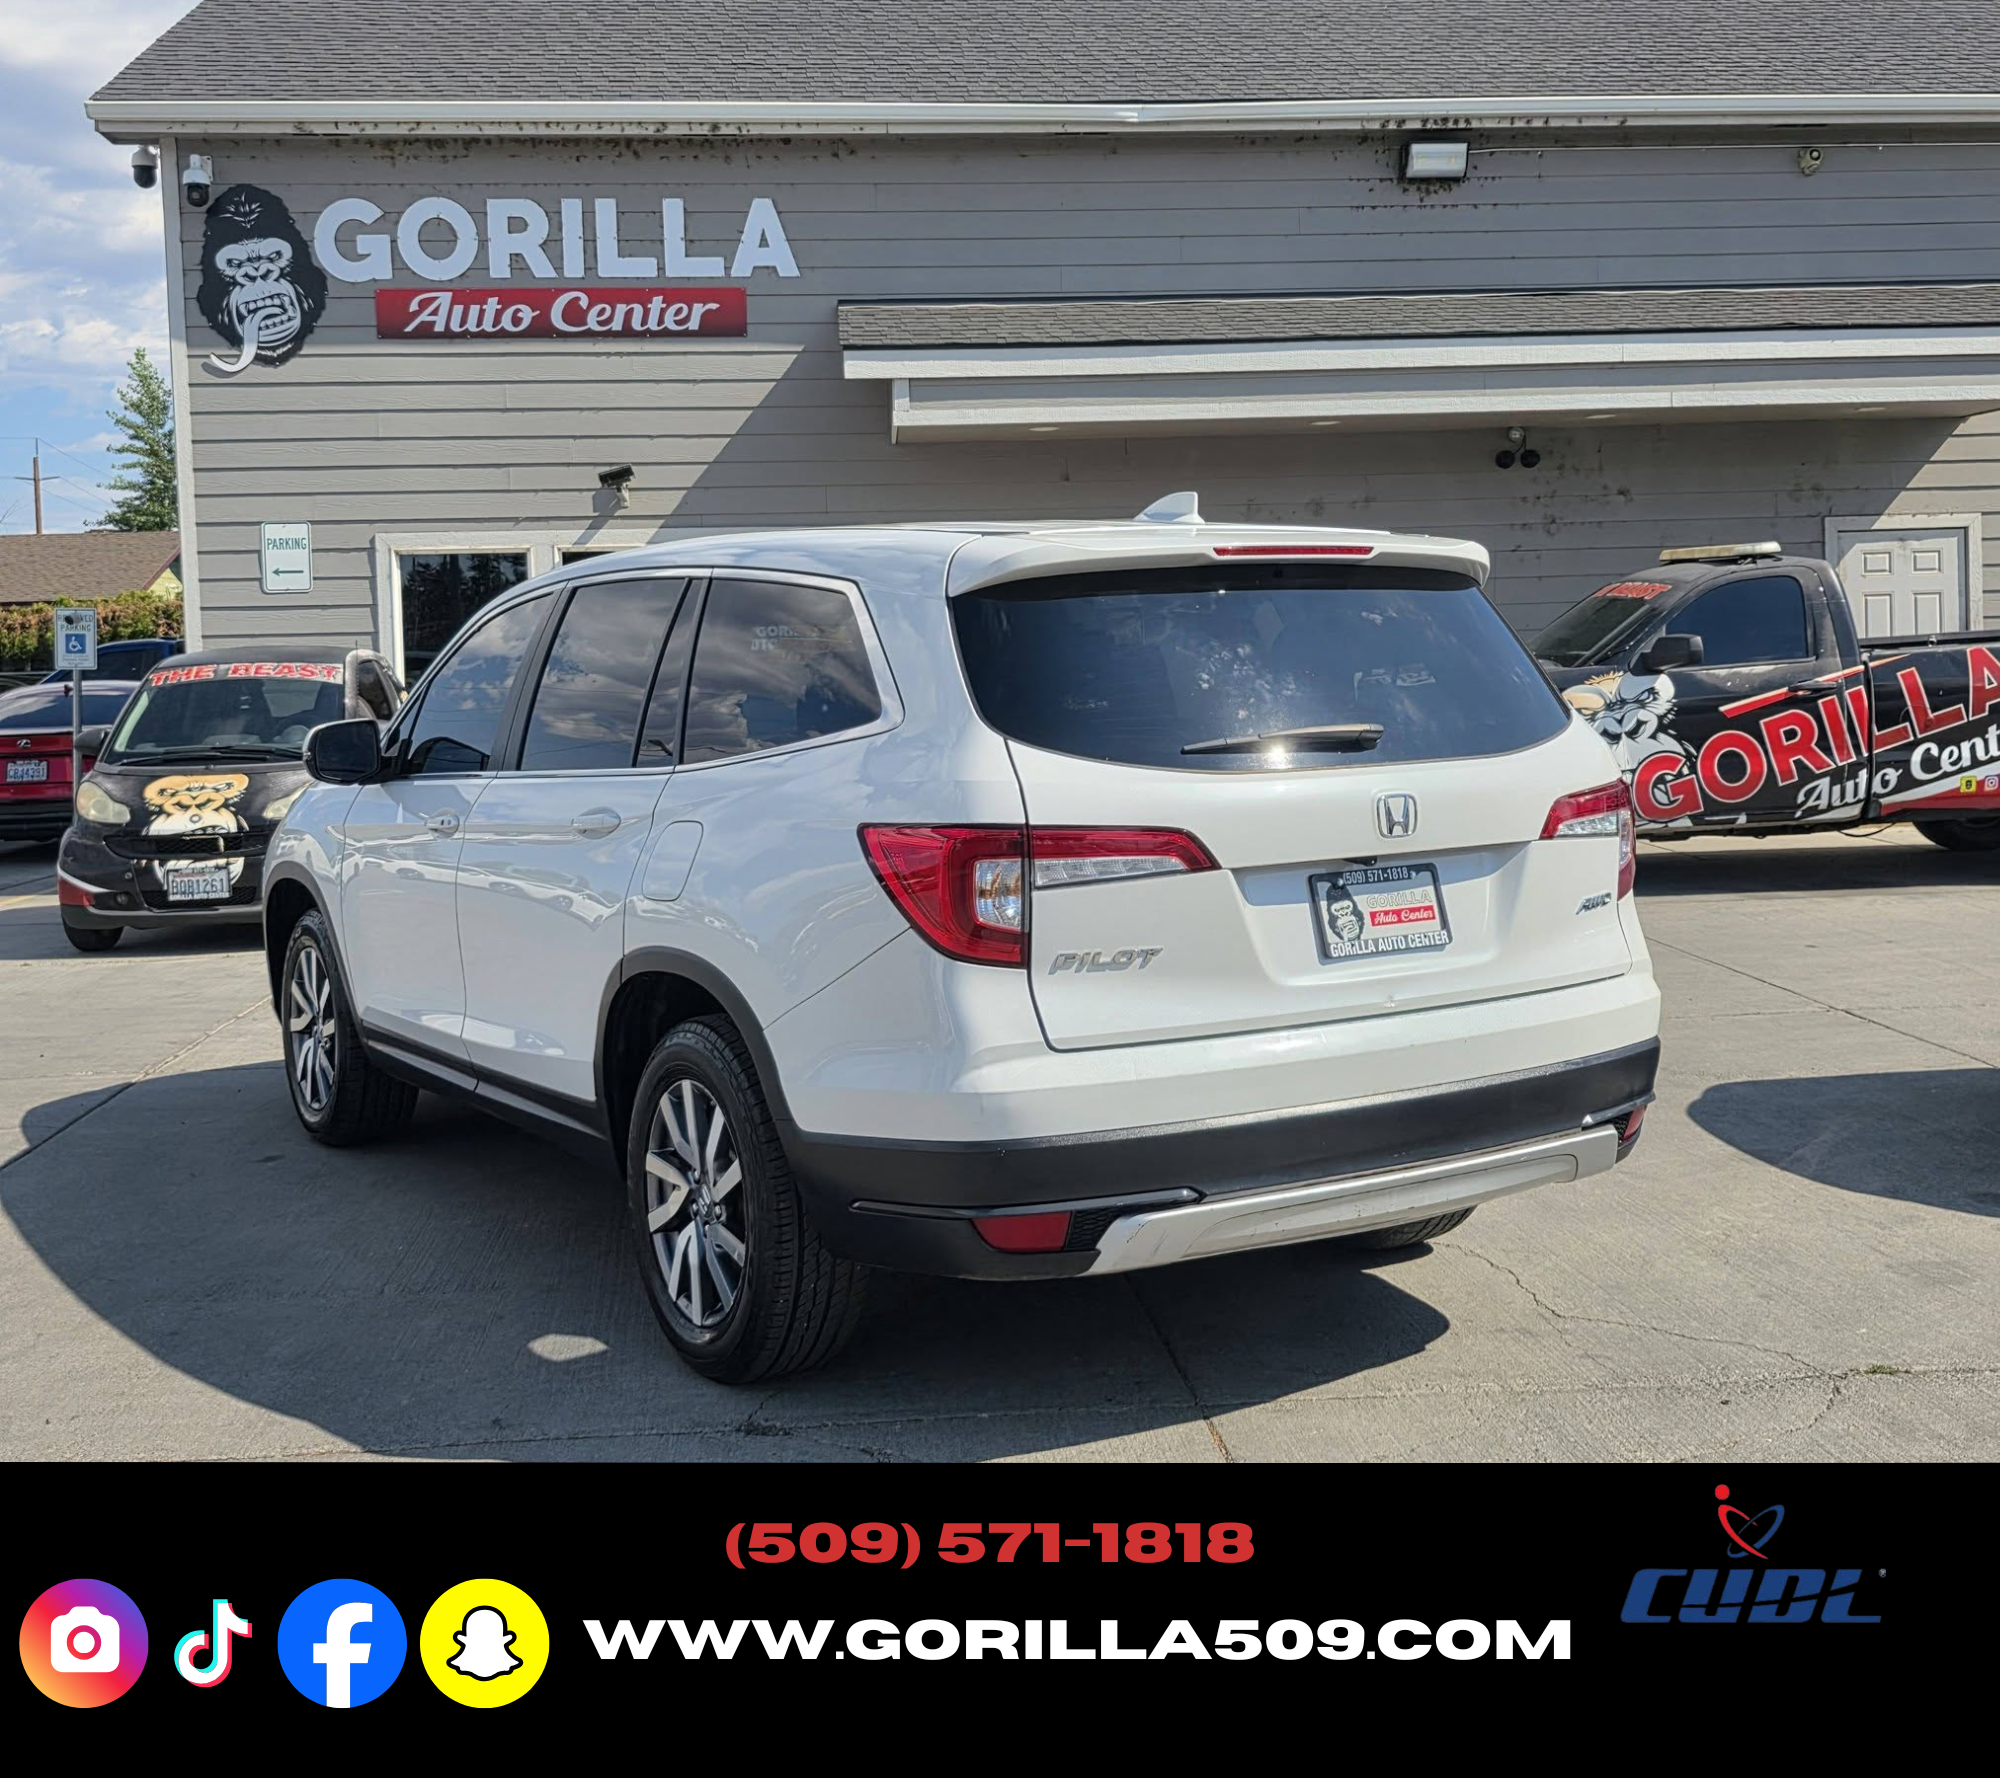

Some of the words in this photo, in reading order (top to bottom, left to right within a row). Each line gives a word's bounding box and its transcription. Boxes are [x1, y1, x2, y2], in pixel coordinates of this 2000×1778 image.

[314, 197, 800, 282] GORILLA
[404, 291, 541, 333] Auto
[550, 291, 719, 332] Center
[266, 537, 307, 550] PARKING
[60, 624, 92, 632] PARKING
[150, 664, 217, 686] THE
[228, 663, 342, 681] BEAST
[1795, 766, 1902, 818] Auto
[1343, 871, 1366, 885] (509)
[1367, 866, 1409, 882] 571-1818
[1366, 889, 1433, 909] GORILLA
[1374, 911, 1399, 925] Auto
[1401, 908, 1434, 921] Center
[1330, 939, 1376, 957] GORILLA
[1379, 935, 1405, 952] AUTO
[1408, 929, 1450, 948] CENTER
[1048, 948, 1164, 975] PILOT
